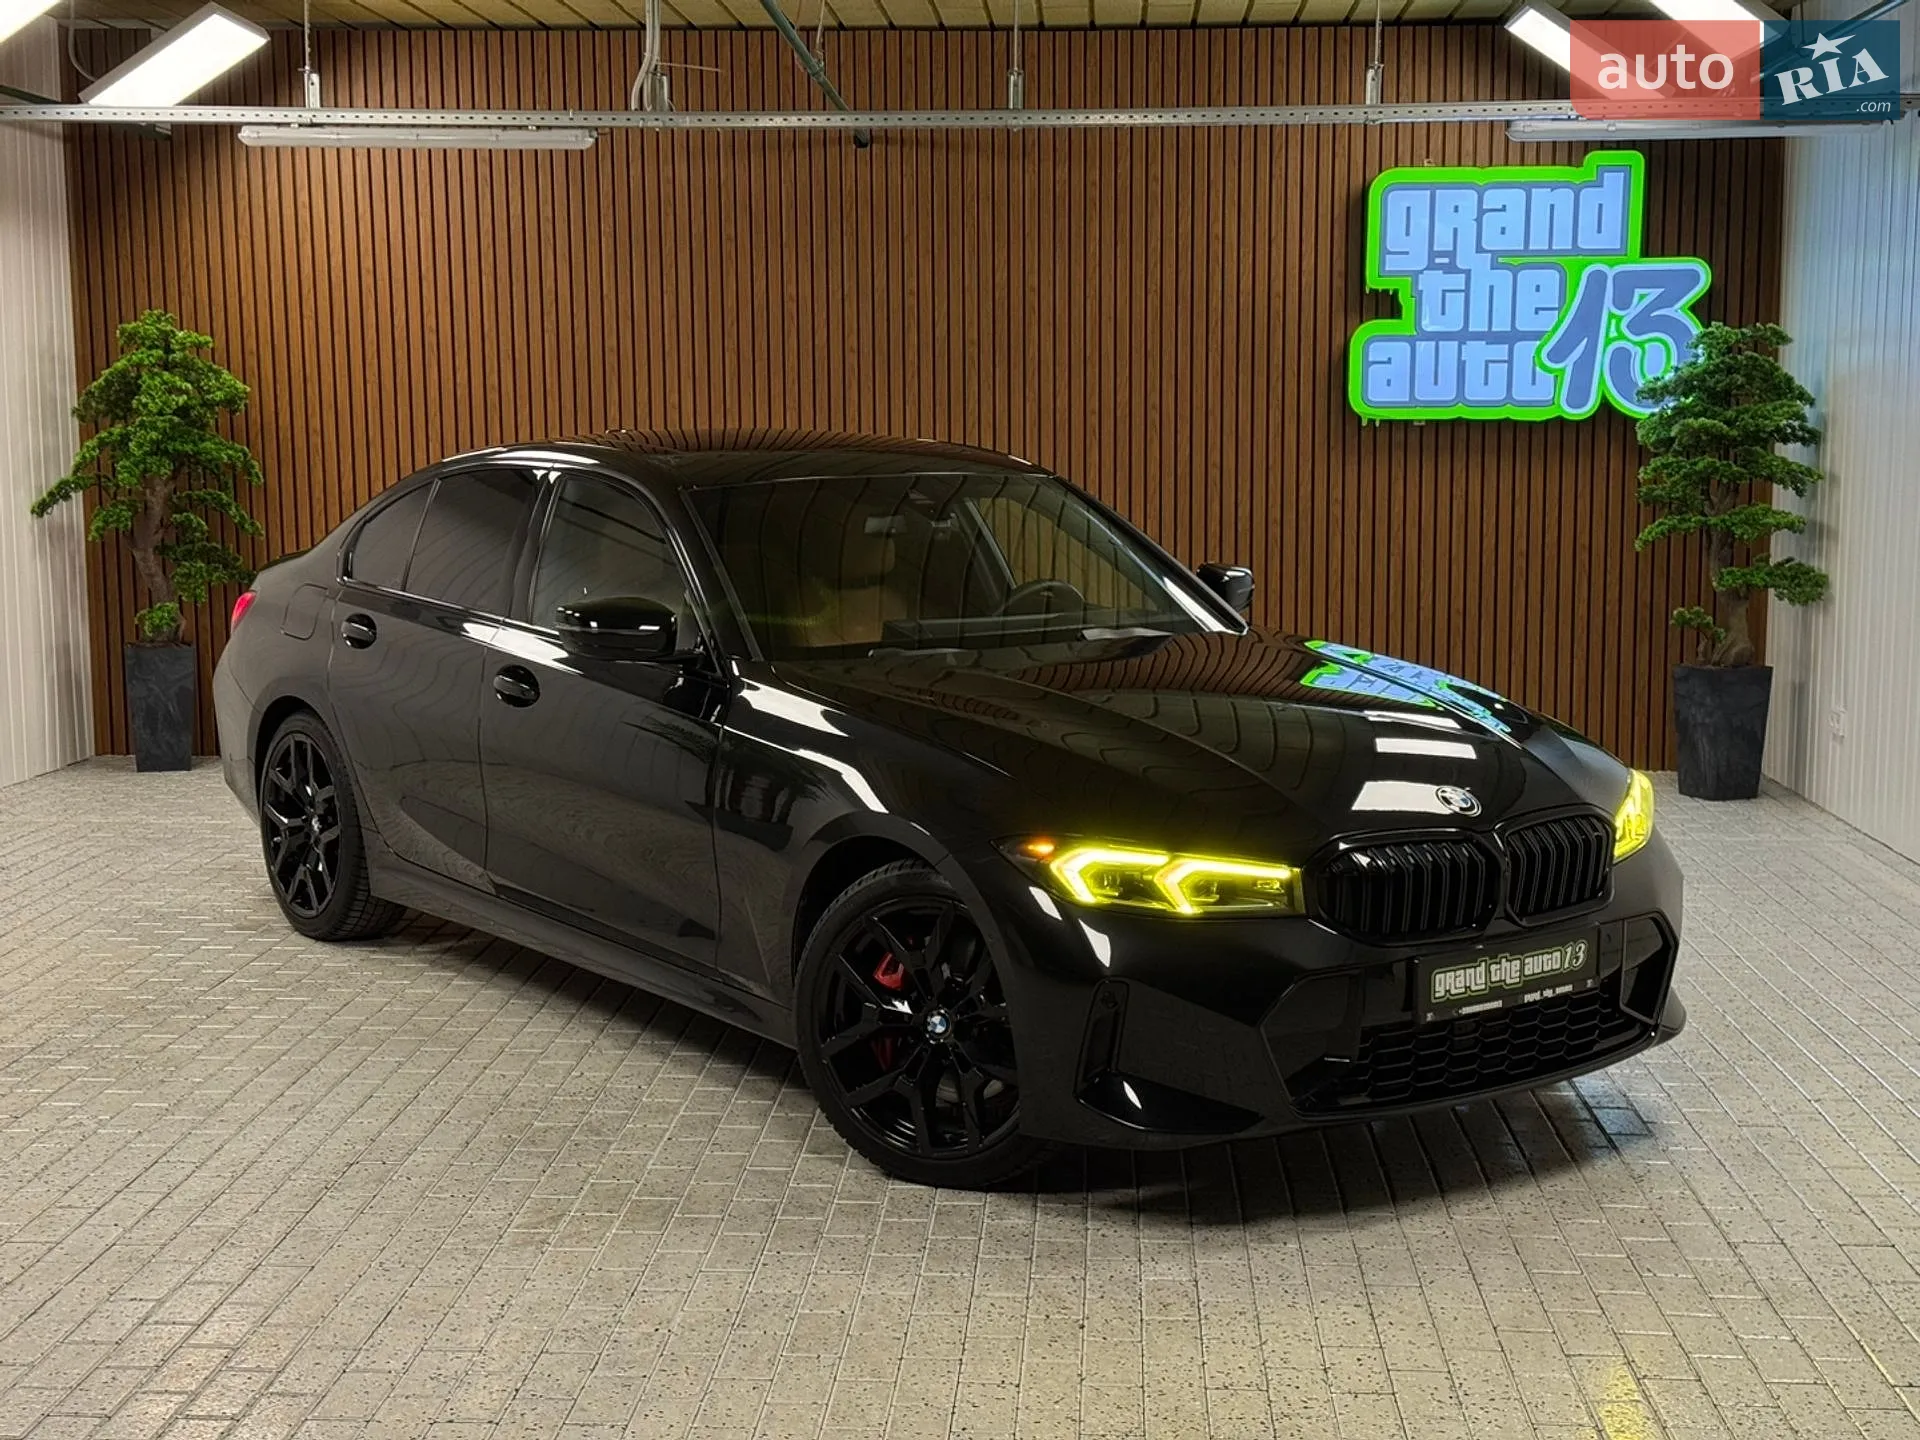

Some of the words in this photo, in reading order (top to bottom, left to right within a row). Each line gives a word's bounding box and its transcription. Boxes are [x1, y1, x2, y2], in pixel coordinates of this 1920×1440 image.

[1418, 252, 1560, 332] the
[1367, 340, 1555, 402] auto
[1541, 264, 1713, 415] 13
[1489, 957, 1521, 985] the
[1523, 950, 1562, 976] auto
[1563, 943, 1586, 969] 13
